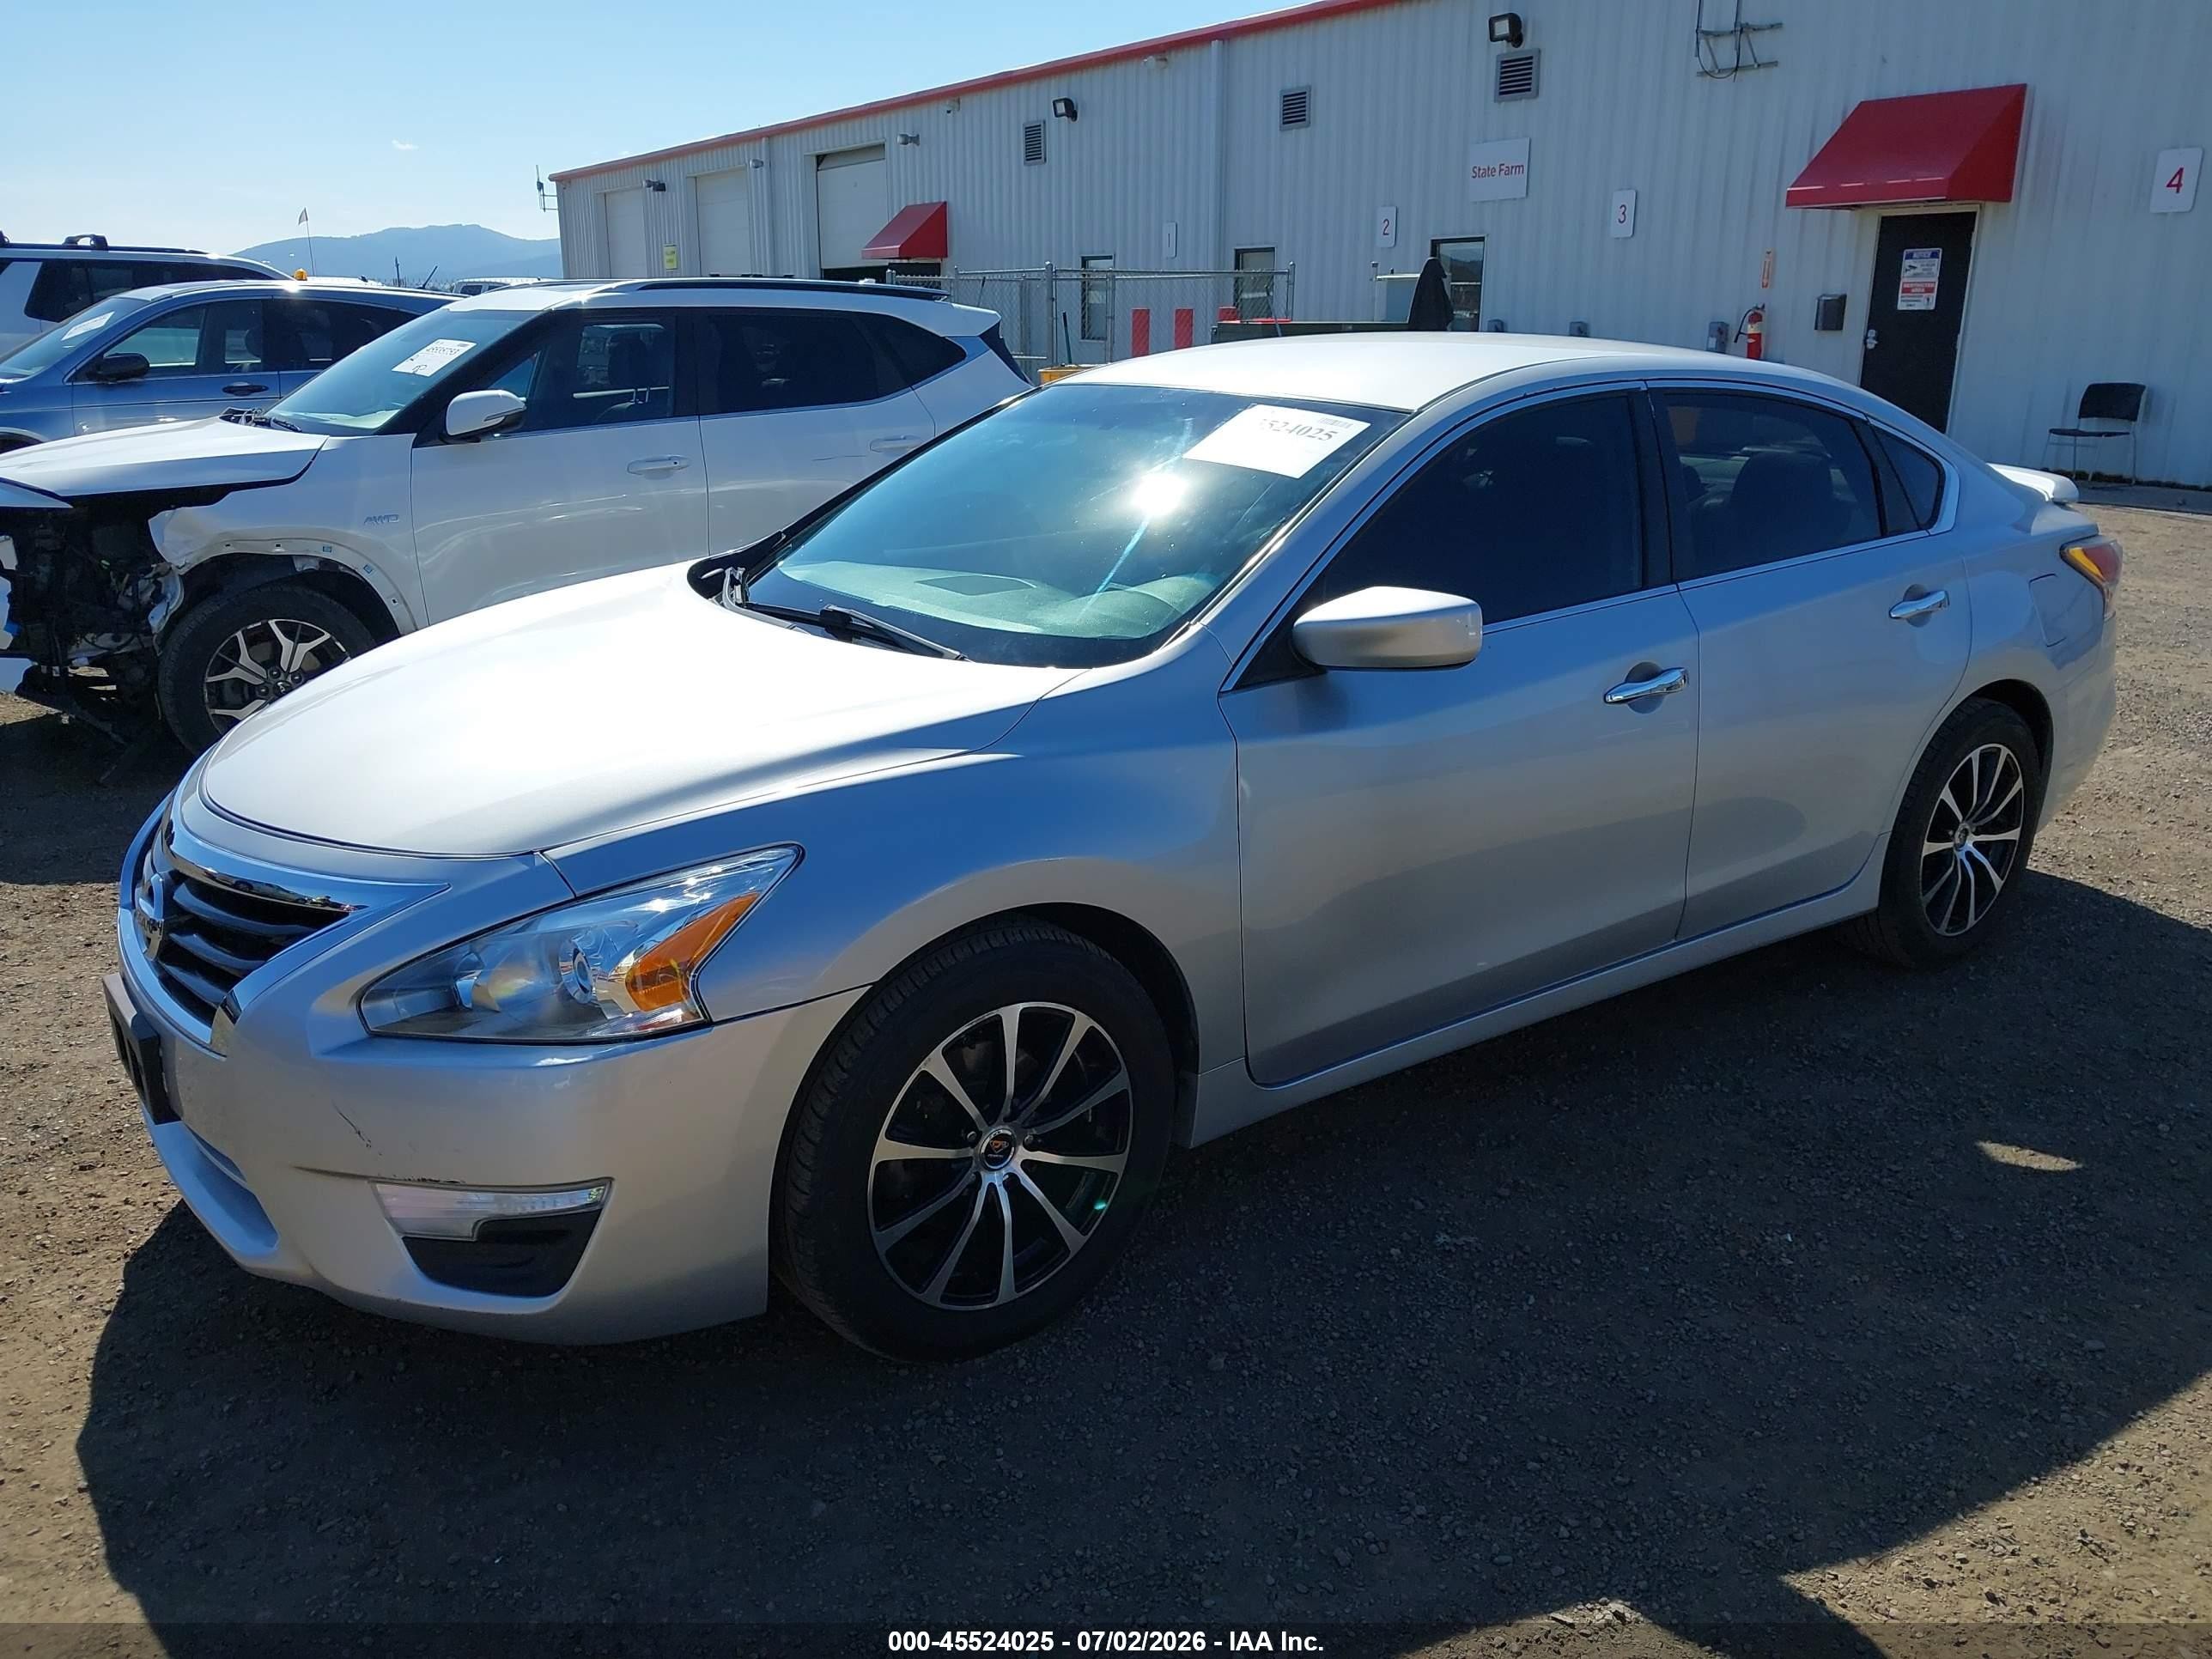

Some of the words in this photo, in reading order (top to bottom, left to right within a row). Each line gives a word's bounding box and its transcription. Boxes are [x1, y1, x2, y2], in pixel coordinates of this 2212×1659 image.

[1471, 165, 1497, 179] State
[1498, 163, 1525, 177] Farm
[2166, 167, 2185, 194] 4
[1618, 204, 1627, 224] 3
[1382, 218, 1390, 236] 2
[363, 514, 398, 524] AWD
